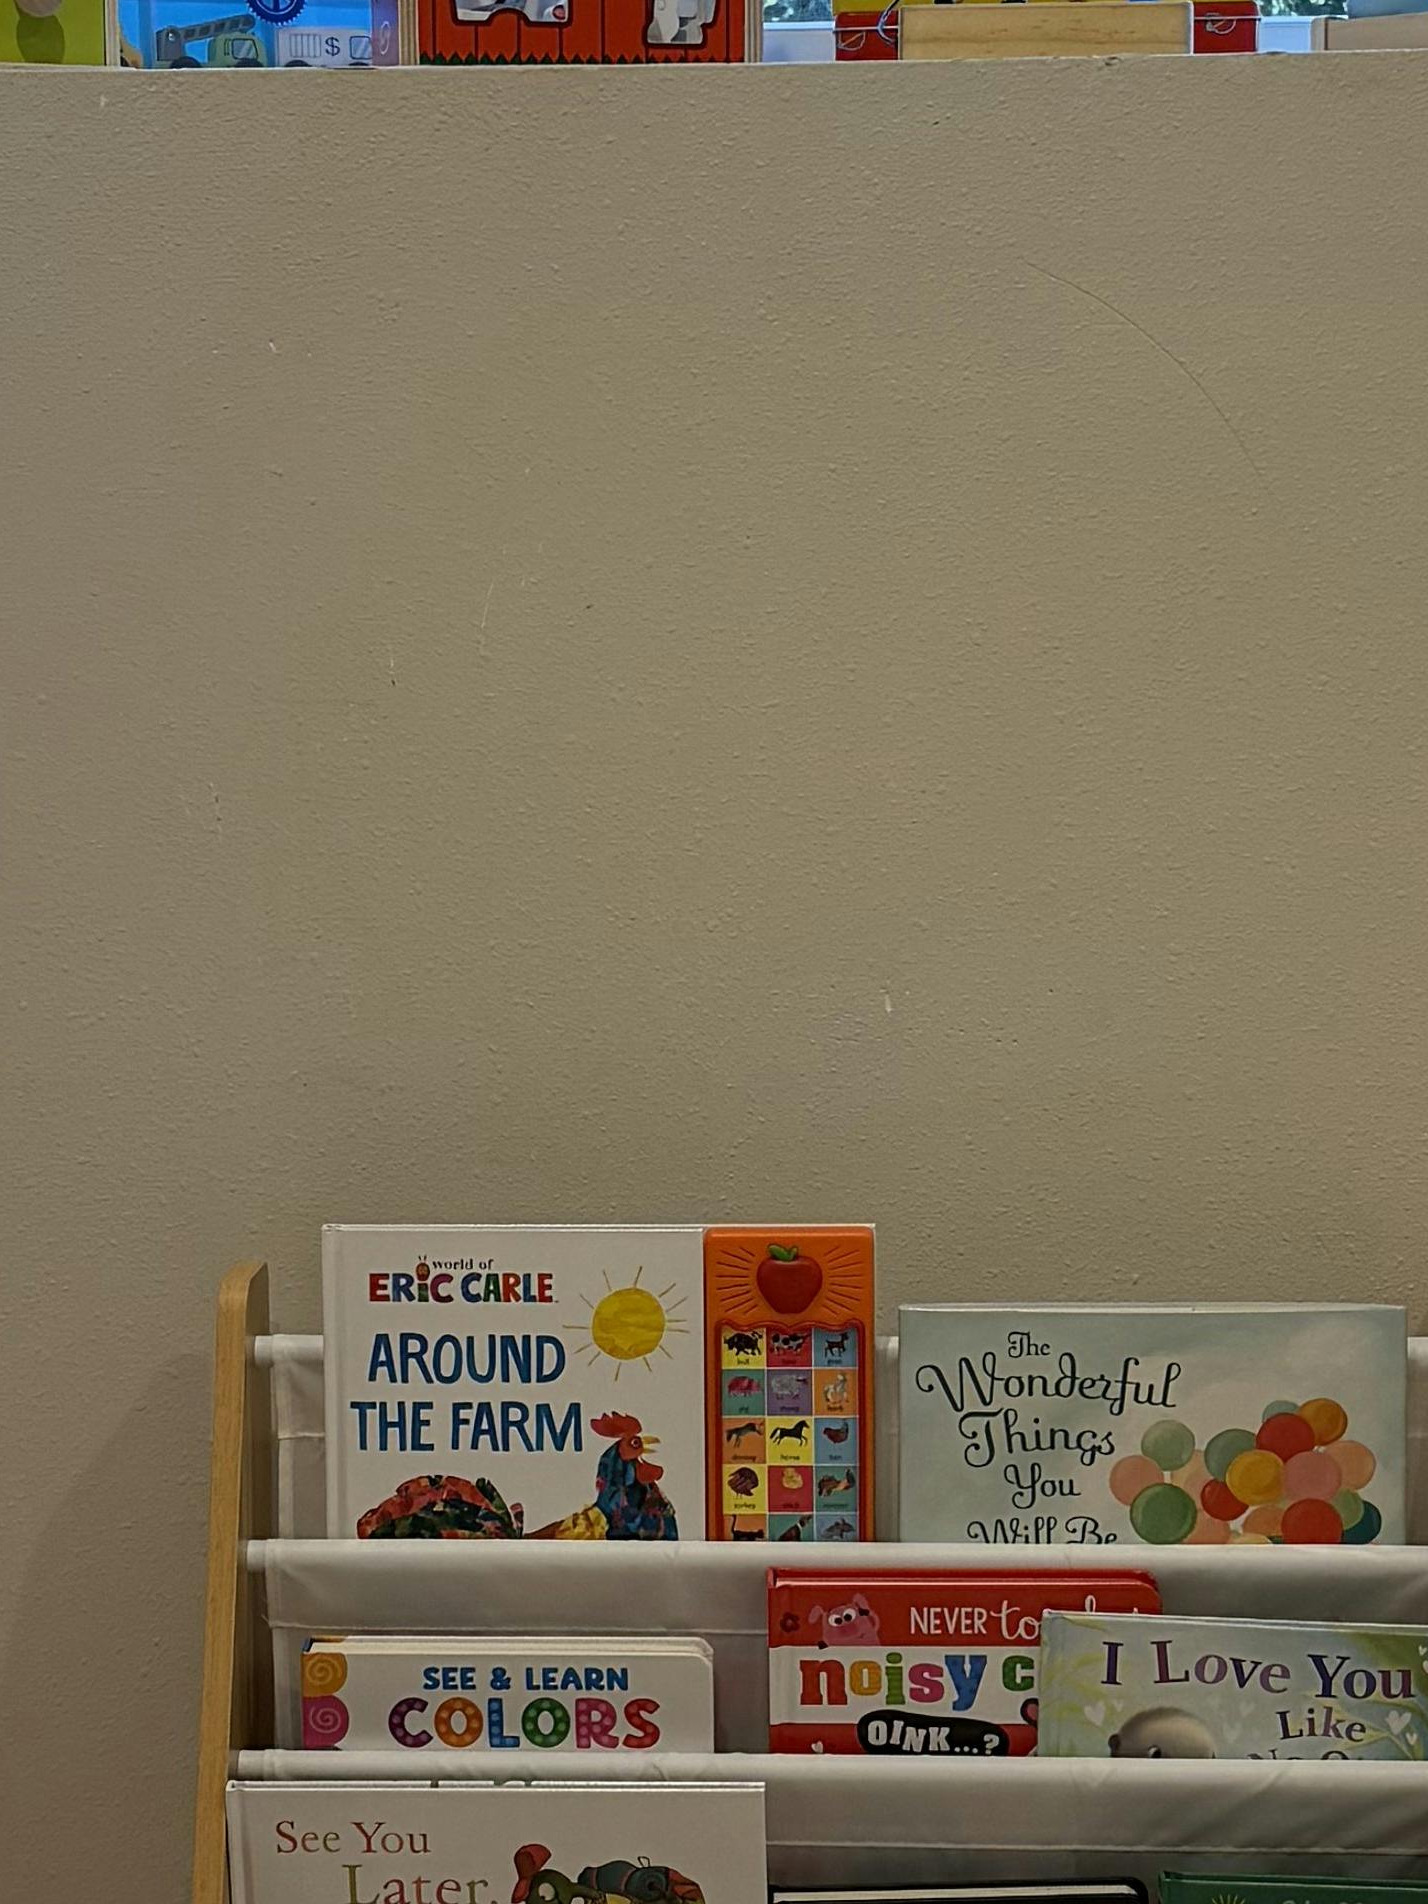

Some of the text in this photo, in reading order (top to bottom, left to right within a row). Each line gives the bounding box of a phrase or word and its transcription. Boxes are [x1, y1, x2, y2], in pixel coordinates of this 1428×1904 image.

[432, 1258, 494, 1270] world of
[460, 1271, 554, 1303] CARLE
[368, 1332, 566, 1385] AROUND
[1007, 1330, 1052, 1359] The
[915, 1351, 1182, 1417] Wonderful
[350, 1402, 584, 1453] THE FARM
[957, 1407, 1117, 1469] Things
[1003, 1462, 1083, 1510] You
[966, 1515, 1118, 1544] Will Be
[909, 1606, 988, 1635] NEVER
[422, 1666, 629, 1691] SEE & LEARN
[798, 1652, 988, 1712] noisy
[1100, 1640, 1416, 1700] I Love You
[388, 1696, 662, 1749] COLORS
[1275, 1705, 1368, 1743] Like
[274, 1819, 432, 1855] See You
